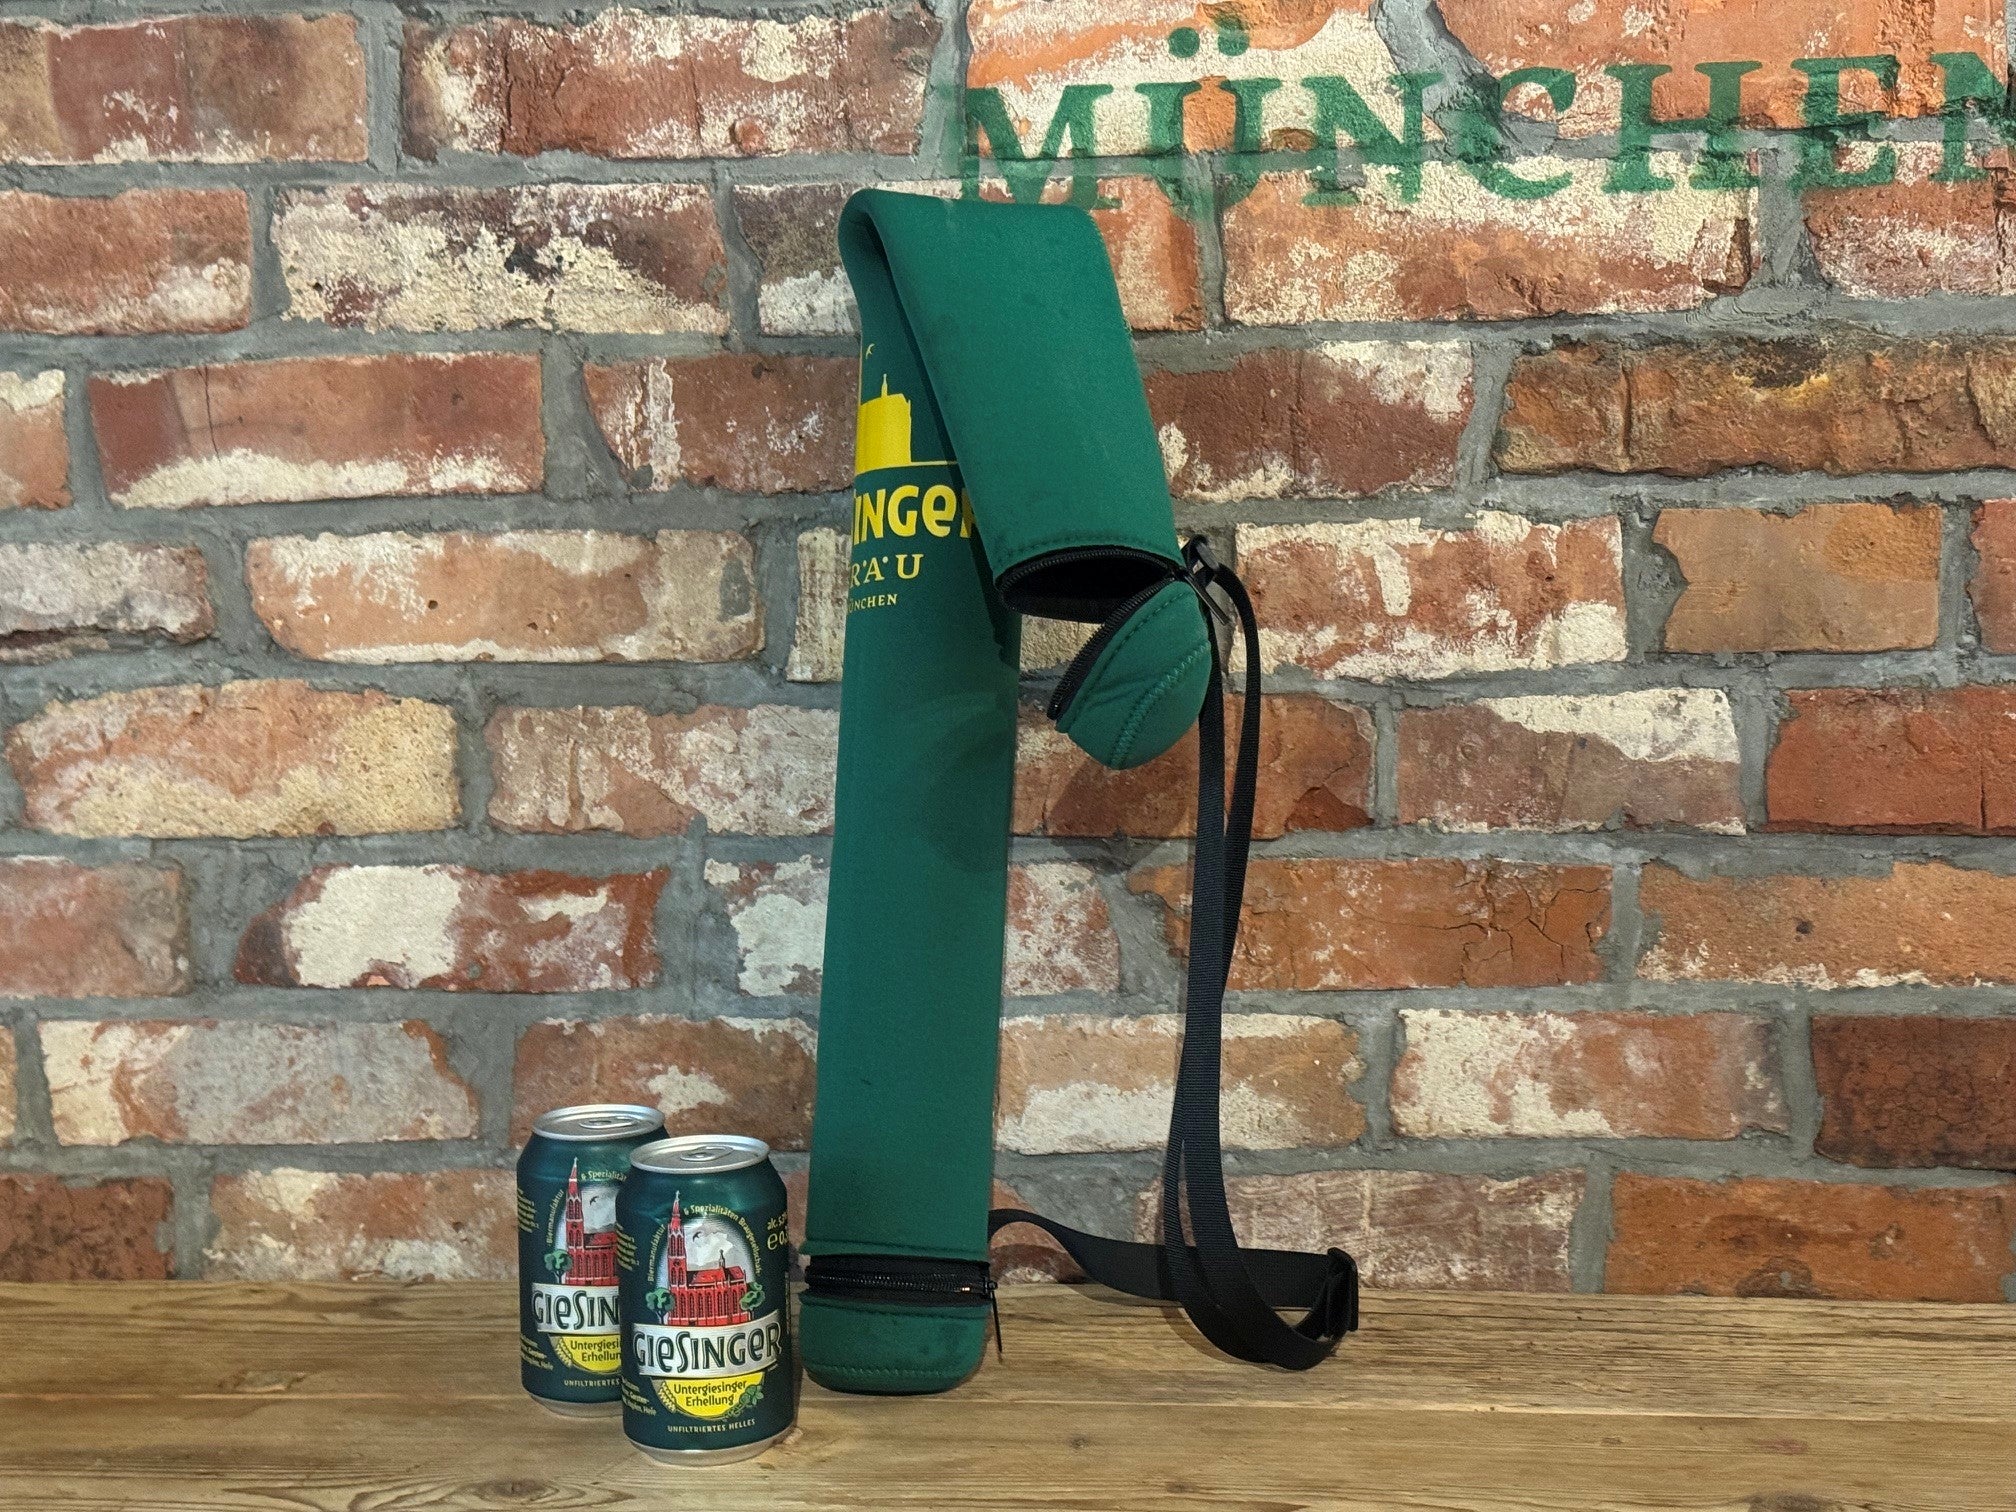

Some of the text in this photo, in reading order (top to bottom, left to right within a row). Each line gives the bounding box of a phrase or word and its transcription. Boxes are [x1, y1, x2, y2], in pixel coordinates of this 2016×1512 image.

[950, 16, 2016, 210] MÜNCHEN
[849, 553, 924, 588] RÄU
[570, 1338, 620, 1352] Untergiesi
[581, 1351, 621, 1362] Erhellun
[673, 1380, 747, 1396] Untergiesinger
[685, 1394, 735, 1407] Erhellung
[667, 1418, 756, 1433] UNFILTRIERTES HELLES
